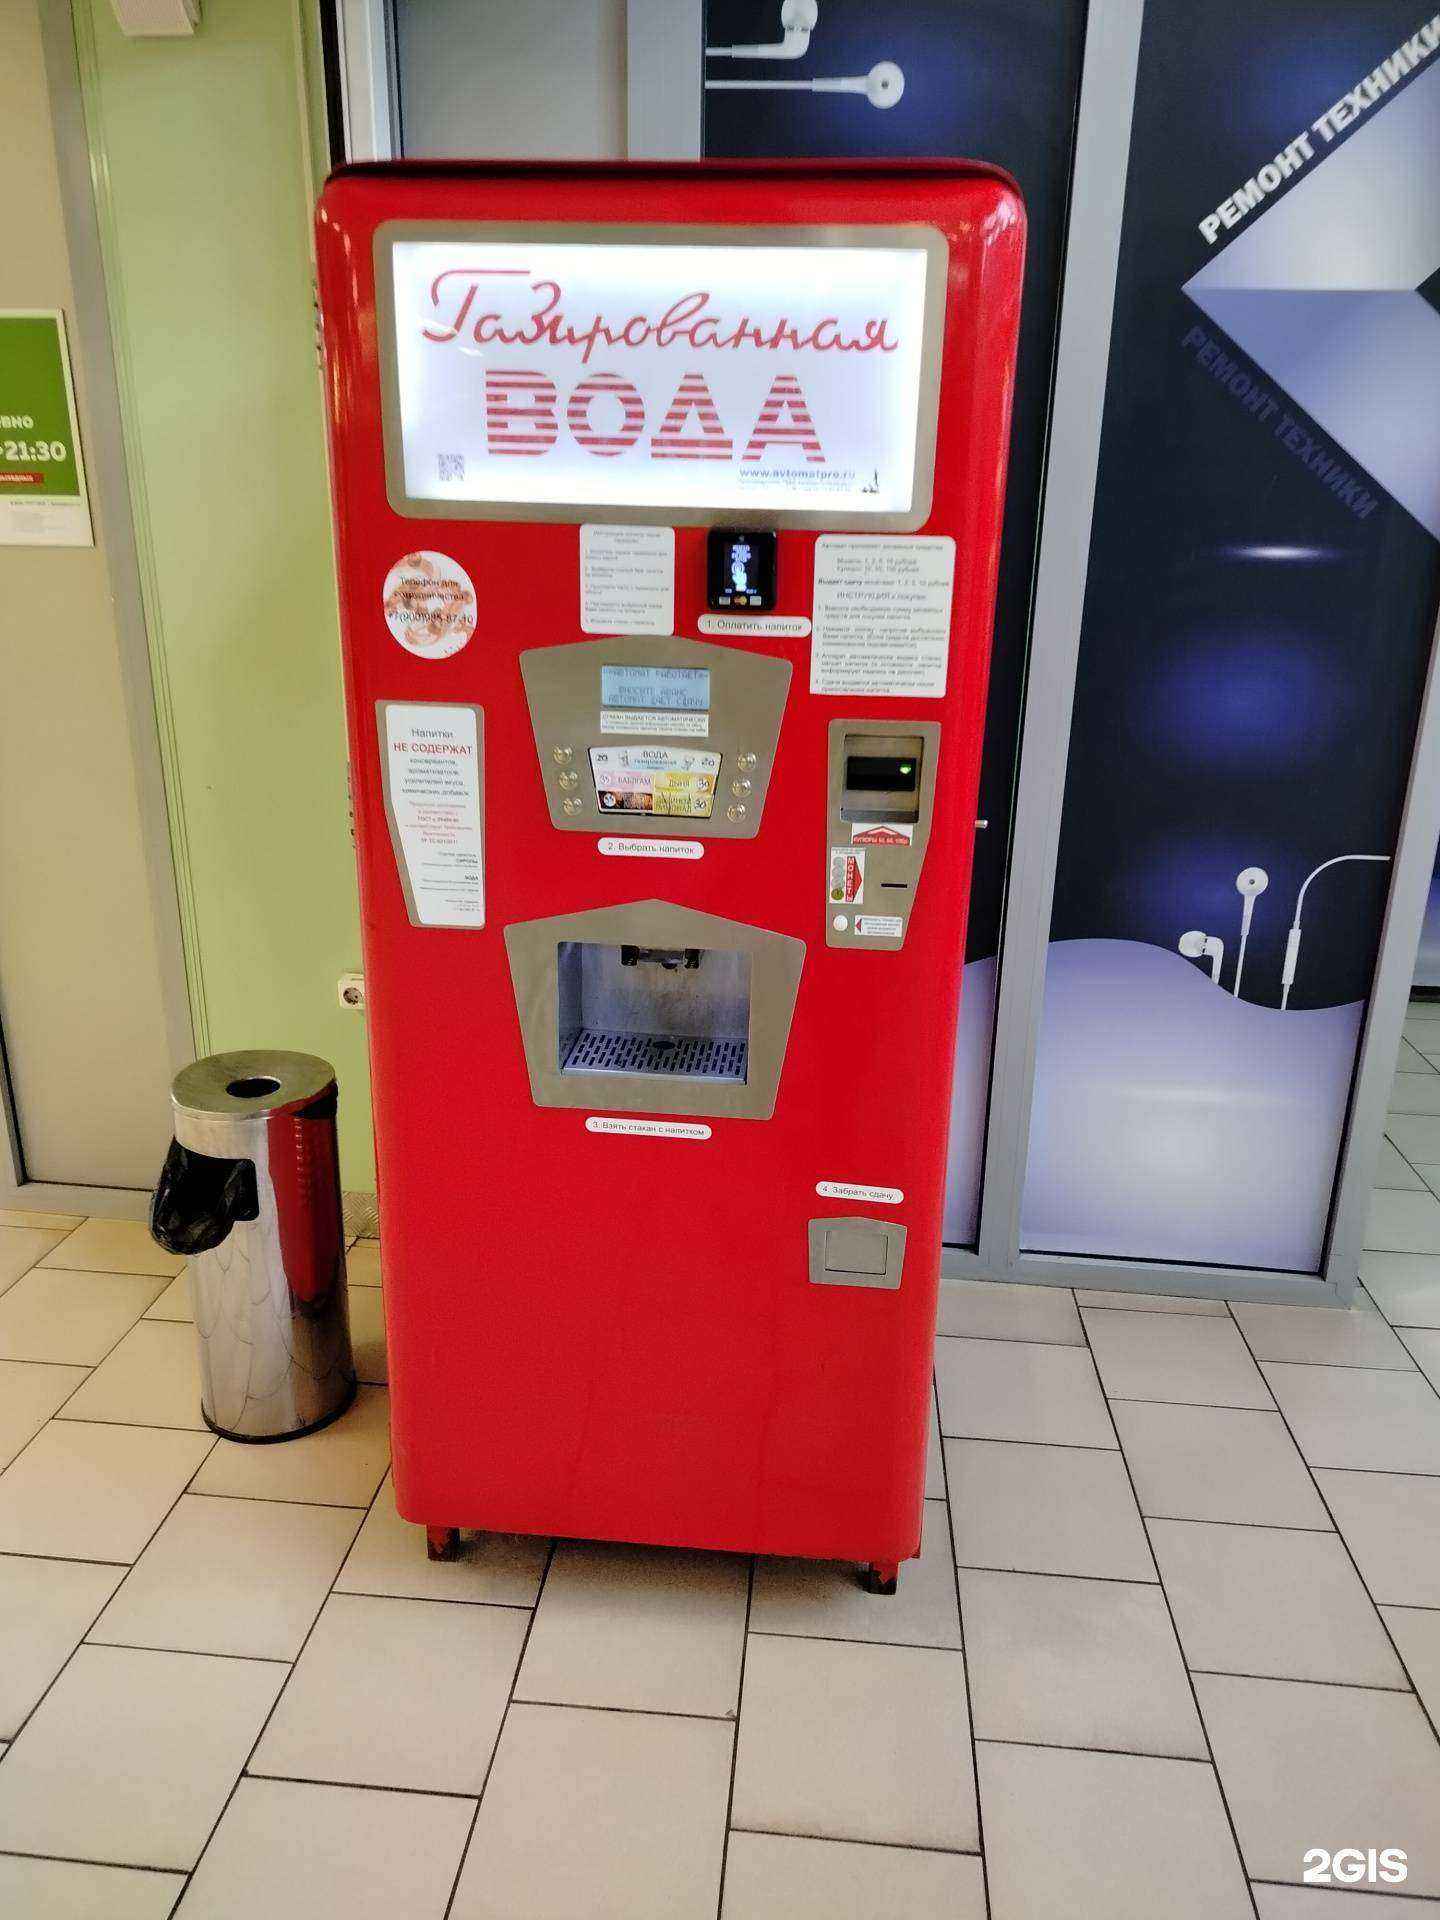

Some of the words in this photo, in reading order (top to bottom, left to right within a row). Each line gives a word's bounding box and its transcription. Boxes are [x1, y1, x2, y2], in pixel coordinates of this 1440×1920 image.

[1198, 130, 1316, 246] РЕМОНТ
[422, 268, 899, 364] Газированная
[0, 415, 34, 429] ВНО
[484, 369, 827, 463] ВОДА
[1181, 325, 1279, 422] РЕМОНТ
[1274, 414, 1379, 519] ТЕХНИКИ
[739, 467, 856, 480] www.avtomatpro.ru
[717, 619, 761, 631] Оплатить
[765, 622, 803, 632] напиток
[411, 727, 453, 739] Напитки
[393, 742, 409, 752] НЕ
[411, 742, 472, 755] СОДЕРЖАТ
[643, 751, 669, 760] ВОДА
[618, 843, 657, 855] Выбрать
[659, 846, 696, 855] напиток
[602, 1121, 627, 1130] Взять
[628, 1124, 657, 1133] стакан
[665, 1127, 705, 1137] напитком
[832, 1186, 867, 1197] Забрать
[869, 1191, 895, 1201] сдачу
